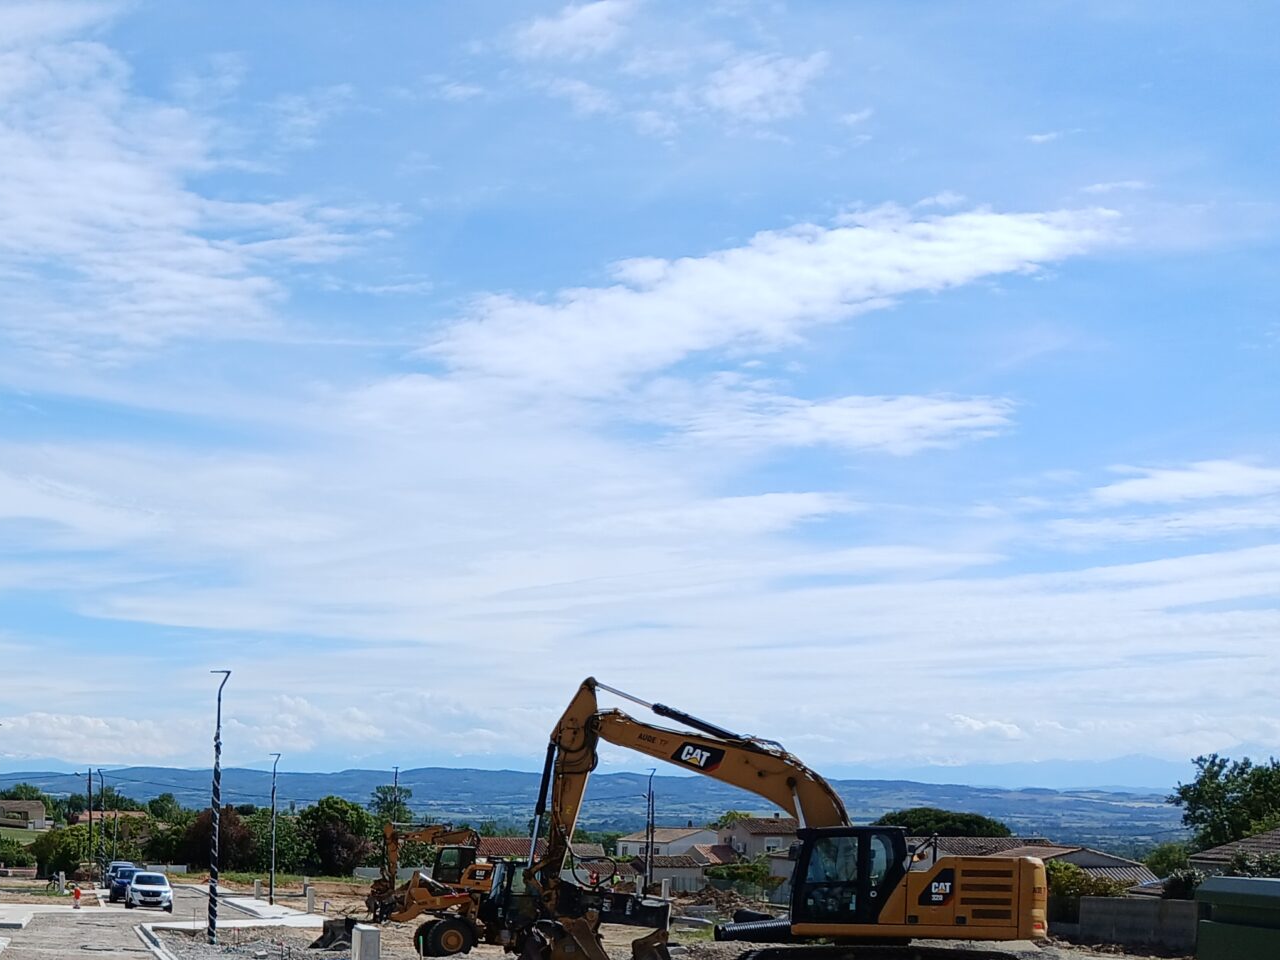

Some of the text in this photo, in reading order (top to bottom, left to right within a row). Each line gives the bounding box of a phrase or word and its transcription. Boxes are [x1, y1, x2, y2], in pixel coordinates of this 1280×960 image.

[637, 732, 657, 744] AUDE
[681, 745, 711, 767] CAT
[931, 882, 952, 894] CAT
